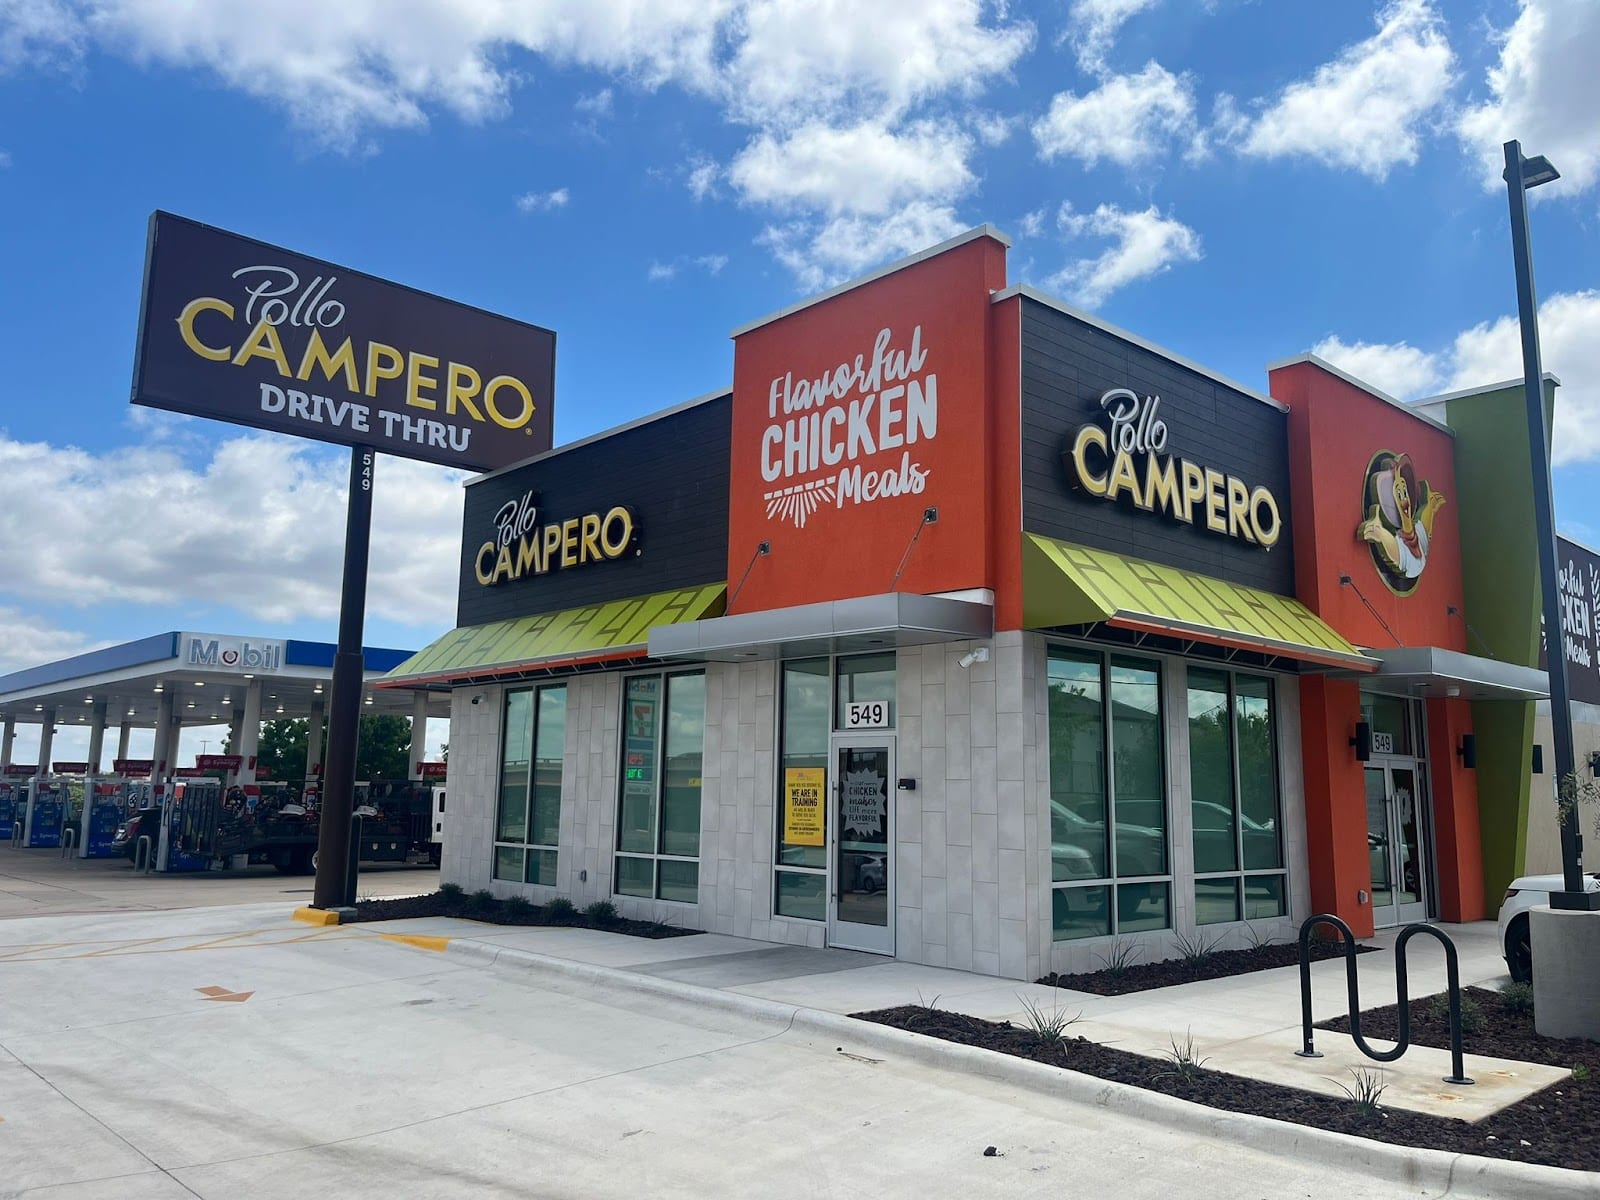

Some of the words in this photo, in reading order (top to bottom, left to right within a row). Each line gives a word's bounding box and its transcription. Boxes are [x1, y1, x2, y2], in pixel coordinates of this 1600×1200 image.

[232, 265, 345, 328] Pollo
[175, 296, 536, 429] CAMPERO
[769, 325, 928, 418] Flavorful
[259, 383, 370, 433] DRIVE
[378, 410, 471, 452] THRU
[761, 373, 938, 482] CHICKEN
[1100, 388, 1168, 454] Pollo
[836, 451, 931, 509] Meals
[1071, 424, 1282, 548] CAMPERO
[475, 506, 633, 586] CAMPERO
[493, 489, 537, 550] Pollo
[1559, 560, 1585, 597] orful
[190, 639, 280, 670] Mobil
[1566, 635, 1592, 668] Meals
[851, 704, 882, 725] 549
[1374, 734, 1391, 751] 549
[791, 788, 800, 797] WE
[801, 788, 811, 797] ARE
[812, 788, 818, 797] IN
[791, 797, 818, 807] TRAINING
[849, 786, 878, 796] CHICKEN
